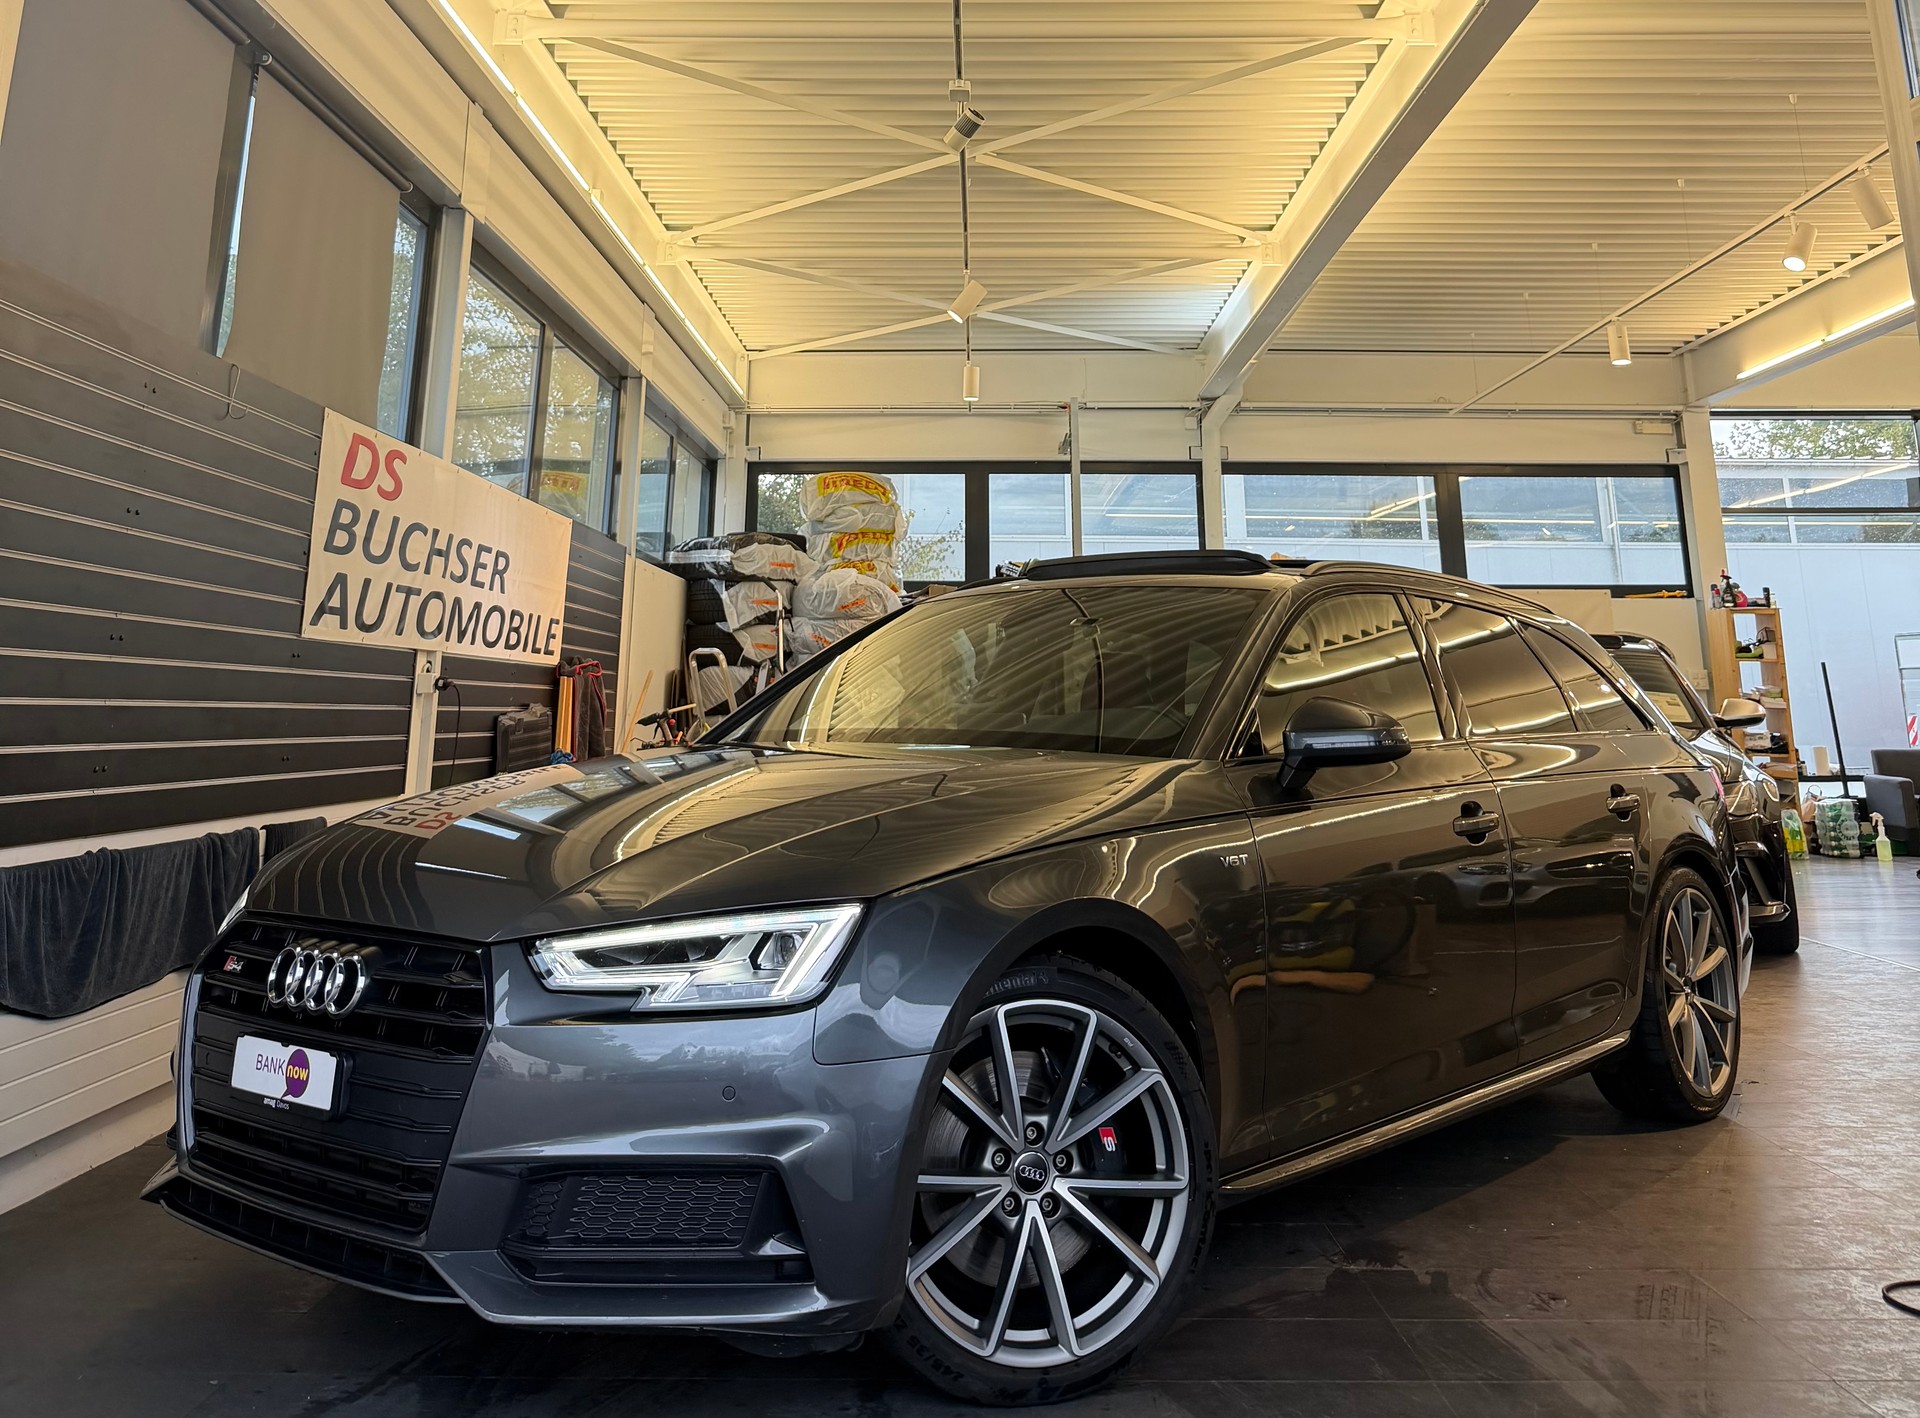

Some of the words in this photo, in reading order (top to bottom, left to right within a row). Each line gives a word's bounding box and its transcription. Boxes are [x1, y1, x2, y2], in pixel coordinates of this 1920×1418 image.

[340, 432, 408, 501] DS
[323, 498, 511, 595] BUCHSER
[309, 572, 560, 656] AUTOMOBILE
[1219, 853, 1248, 868] V6T
[256, 1053, 286, 1076] BANK
[287, 1064, 309, 1081] now
